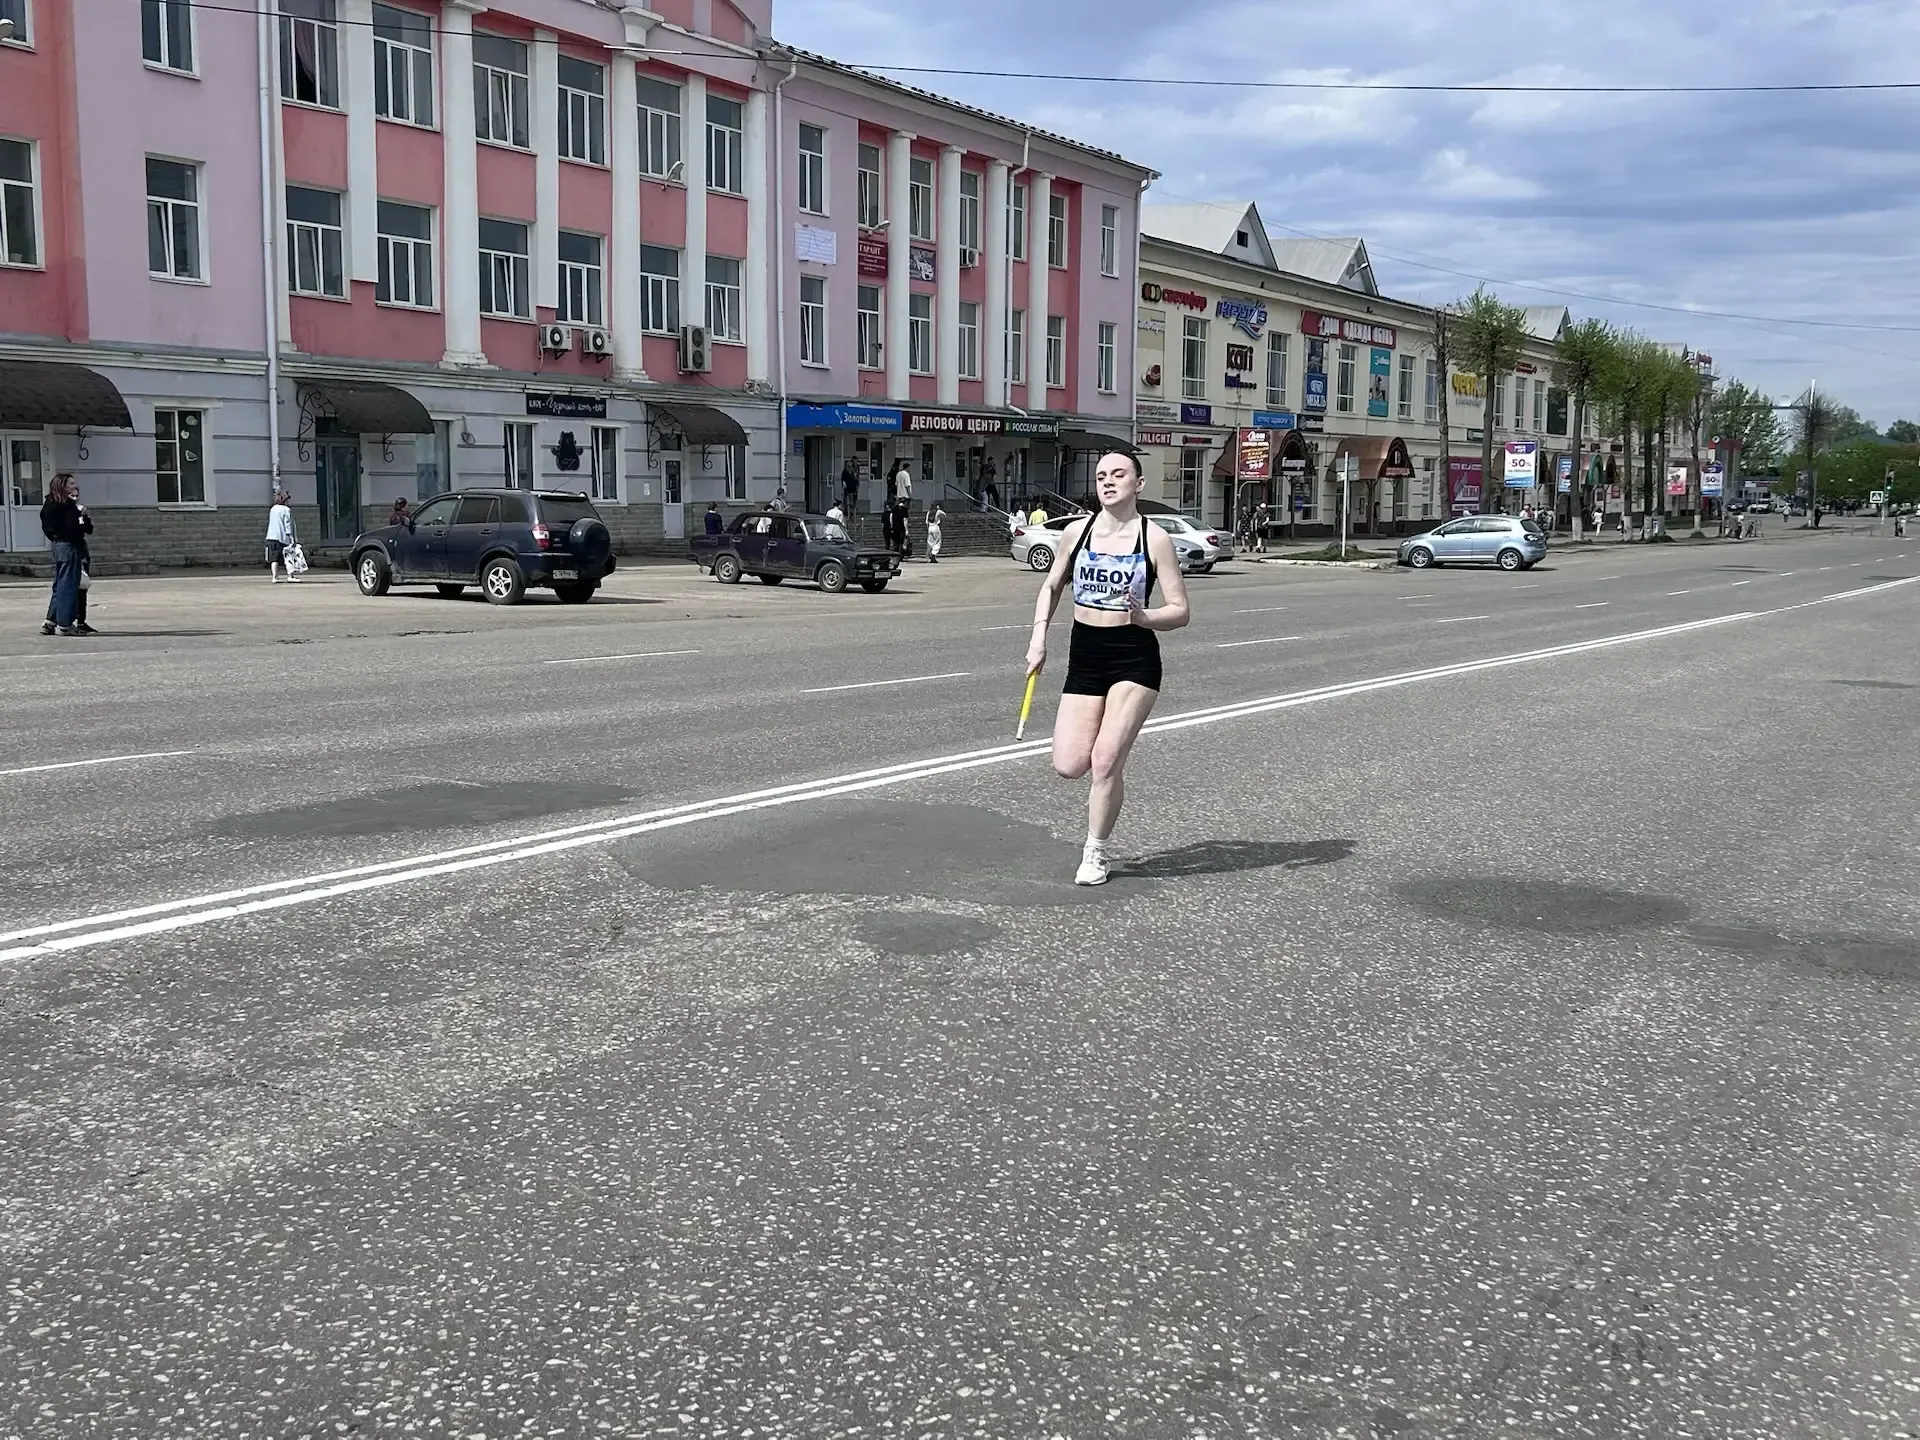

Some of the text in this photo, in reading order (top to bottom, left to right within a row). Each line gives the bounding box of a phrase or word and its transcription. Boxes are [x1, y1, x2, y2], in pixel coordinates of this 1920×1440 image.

[843, 411, 897, 425] Золотой ключик
[910, 415, 1001, 433] ДЕЛОВОЙ ЦЕНТР
[1080, 566, 1135, 585] МБОУ
